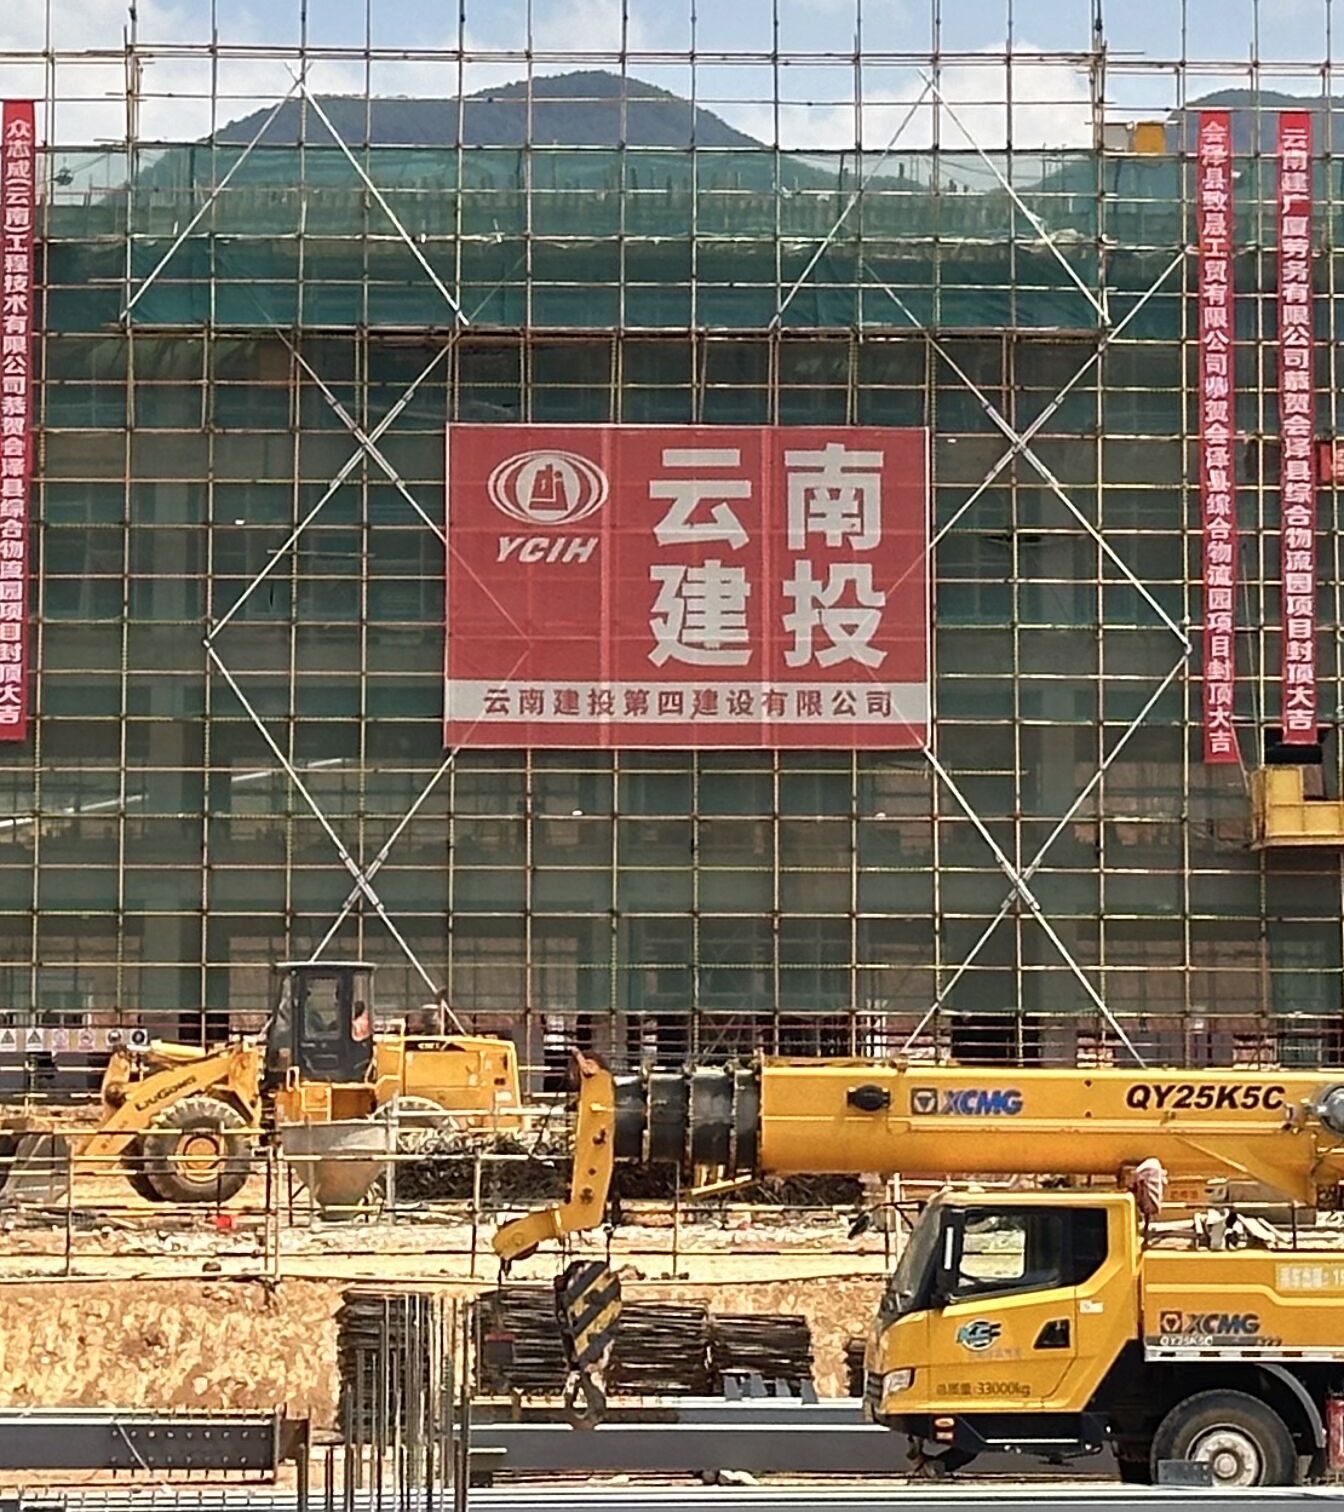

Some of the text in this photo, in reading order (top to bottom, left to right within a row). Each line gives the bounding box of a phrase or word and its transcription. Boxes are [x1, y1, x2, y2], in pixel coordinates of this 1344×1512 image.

[648, 442, 885, 551] 云南
[496, 536, 598, 564] YCIH
[648, 559, 887, 670] 建投
[483, 689, 892, 720] 云南建投第四建设有限公司
[940, 1087, 1024, 1116] XCMG
[1125, 1084, 1285, 1111] QY25K5C
[1184, 1313, 1261, 1334] XCMG
